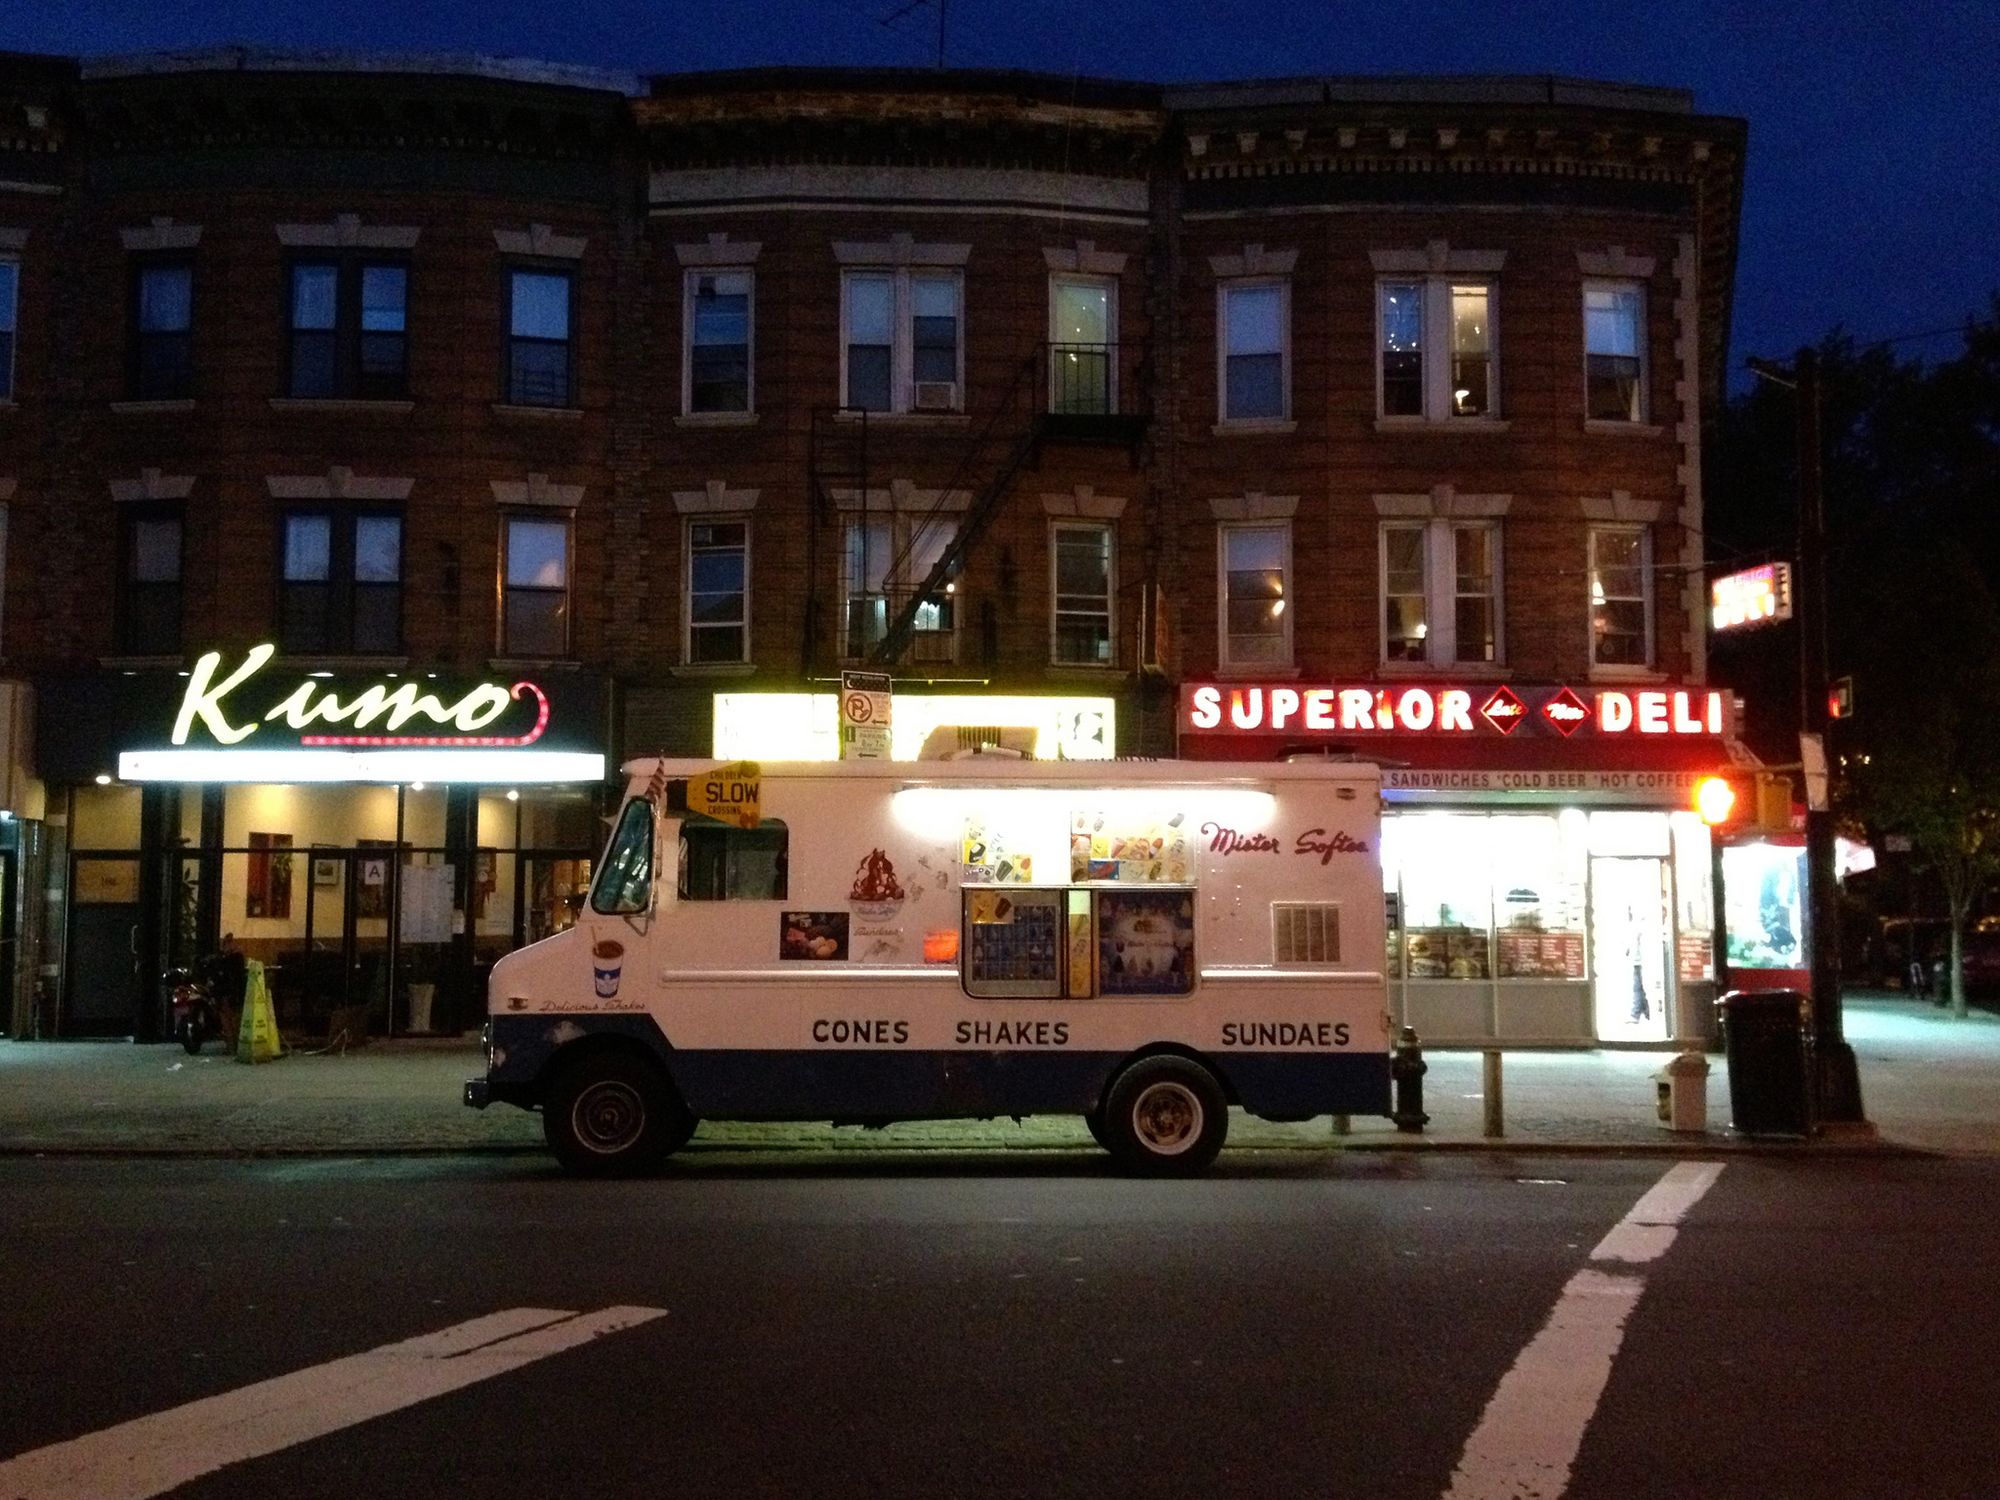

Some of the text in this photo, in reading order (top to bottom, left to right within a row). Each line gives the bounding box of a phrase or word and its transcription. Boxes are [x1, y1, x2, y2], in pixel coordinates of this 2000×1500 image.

[171, 643, 511, 745] Kumo
[1191, 687, 1475, 730] SUPERIOR
[1600, 691, 1722, 734] DELI
[706, 782, 759, 803] SLOW
[1391, 773, 1490, 788] SANDWICHES
[1547, 773, 1587, 788] BEER
[1200, 821, 1369, 866] Mister Softee
[812, 1019, 910, 1044] CONES
[955, 1021, 1070, 1045] SHAKES
[1222, 1023, 1350, 1047] SUNDAES
